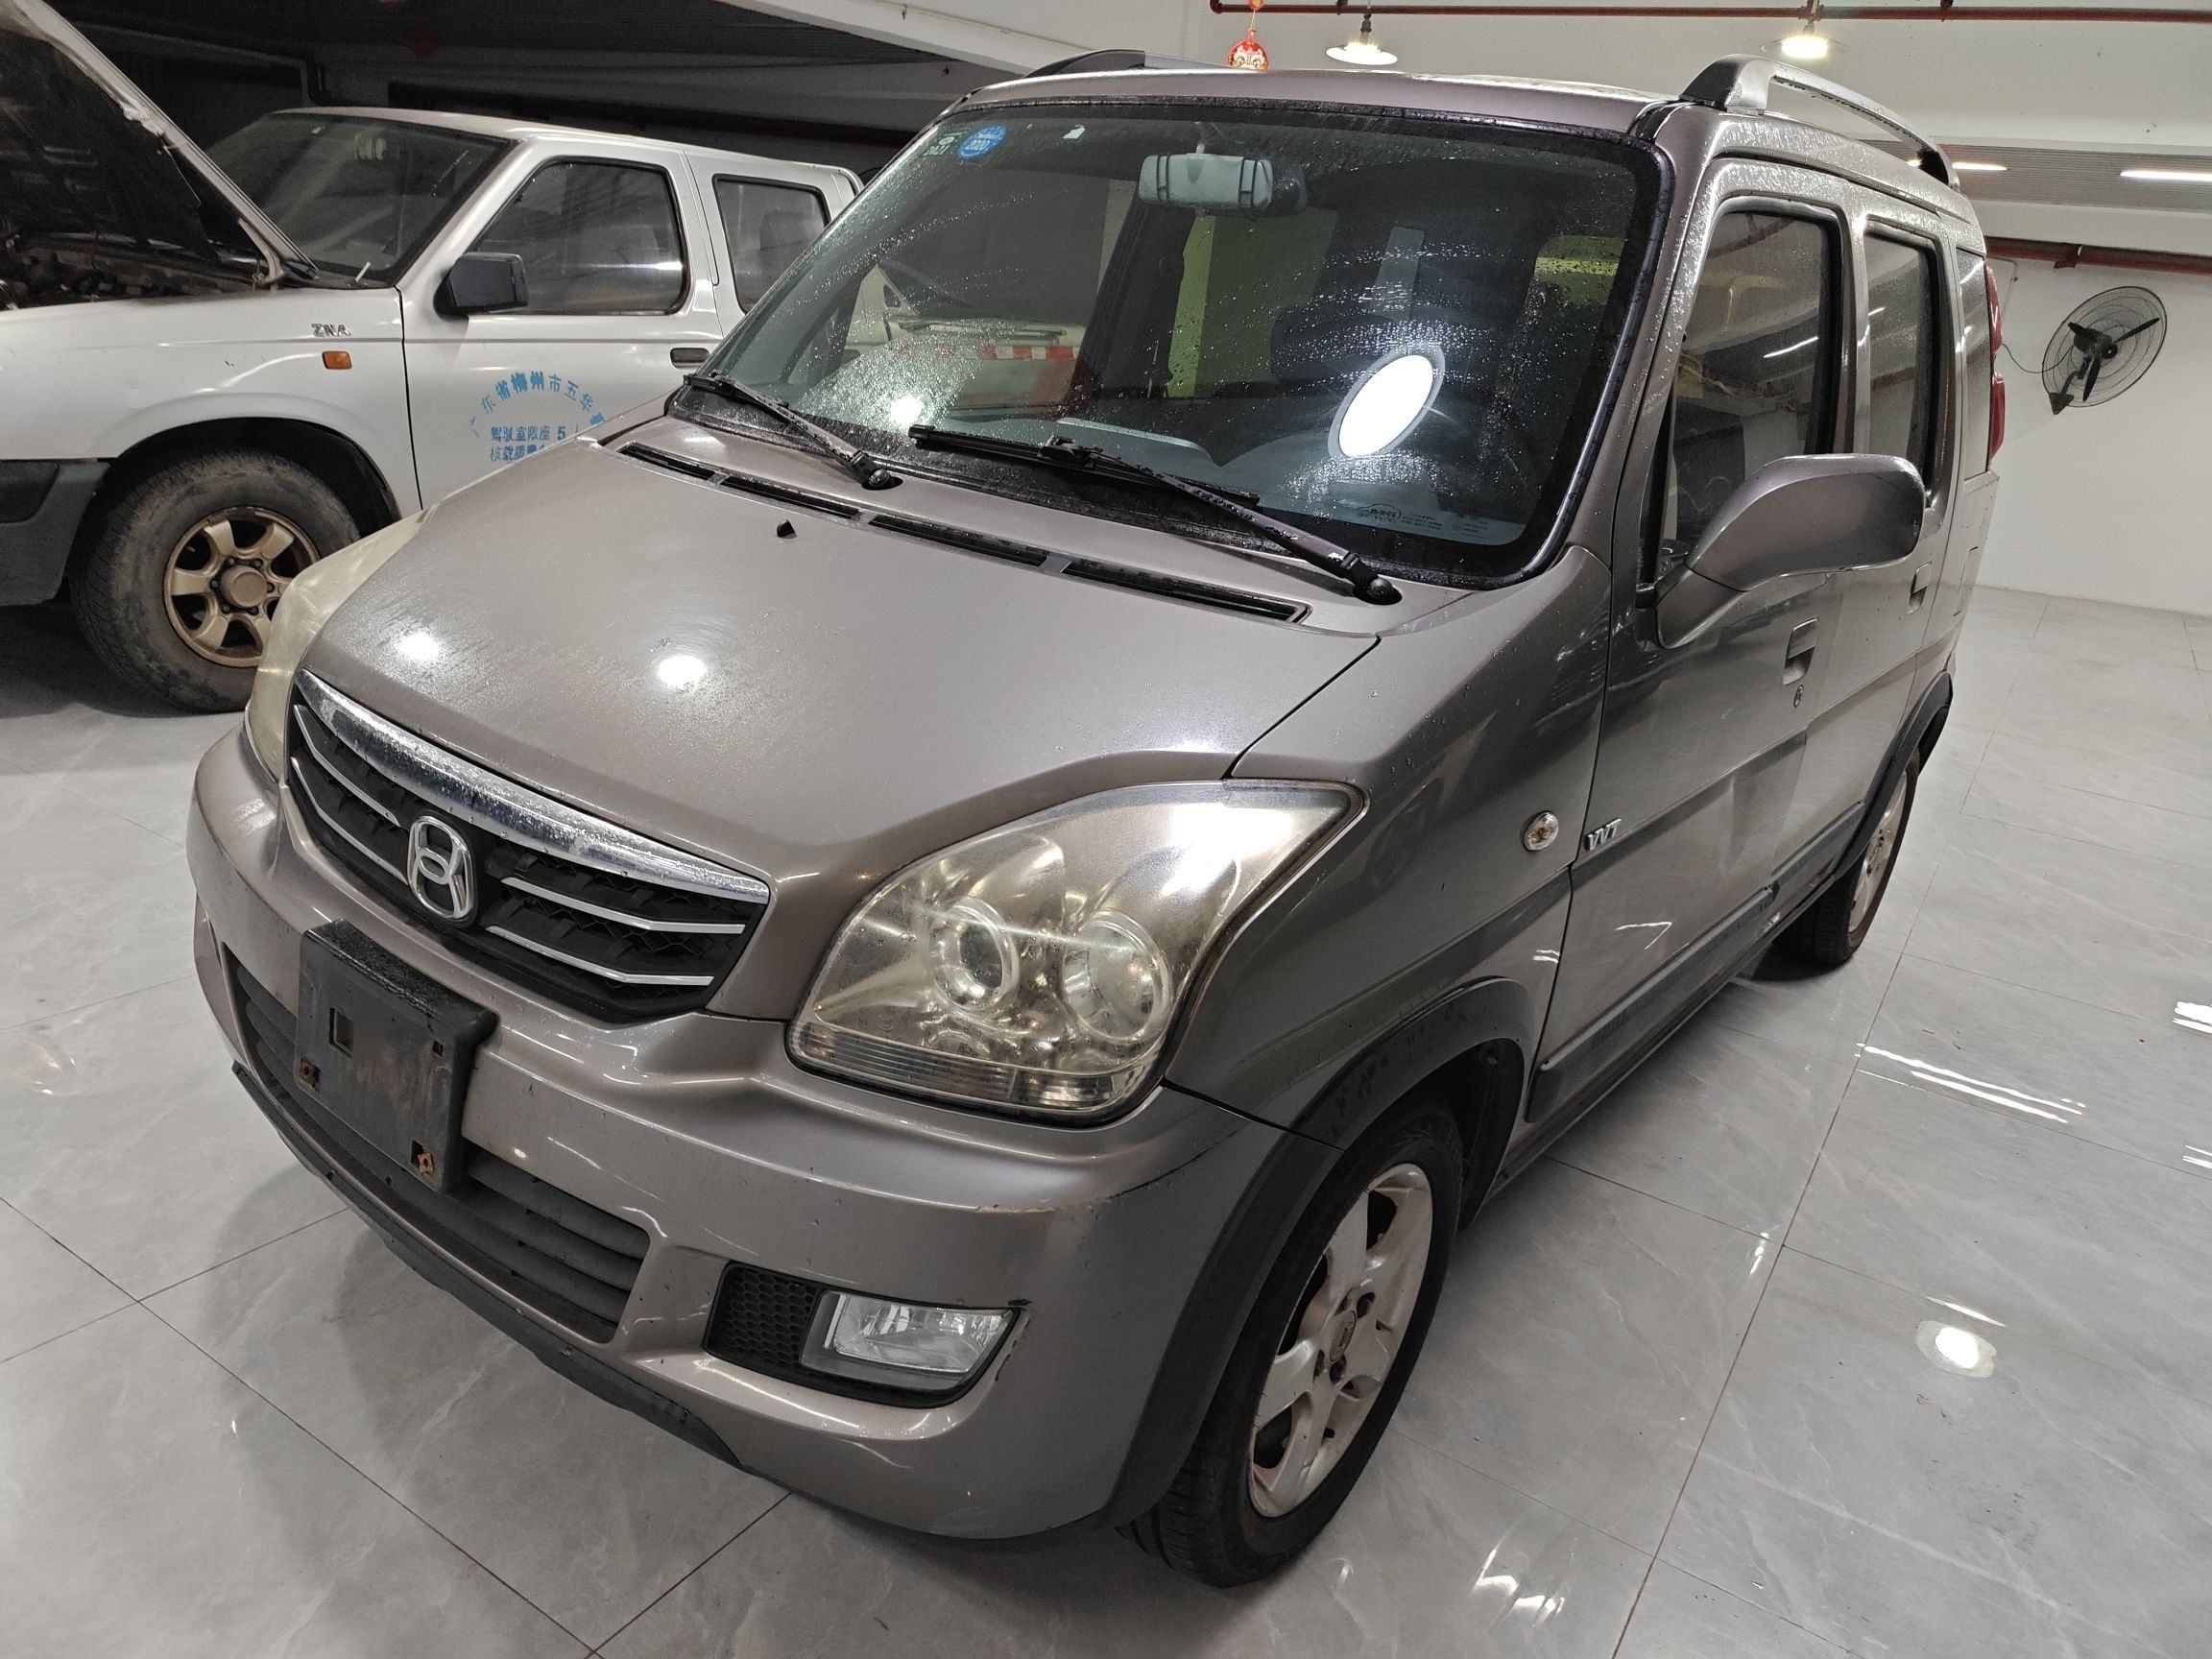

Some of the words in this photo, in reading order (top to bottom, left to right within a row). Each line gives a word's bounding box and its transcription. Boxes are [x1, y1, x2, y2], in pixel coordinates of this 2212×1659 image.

[965, 139, 991, 151] 2020
[311, 323, 351, 337] ZNA
[557, 425, 566, 441] 5
[1585, 818, 1622, 852] VVT
